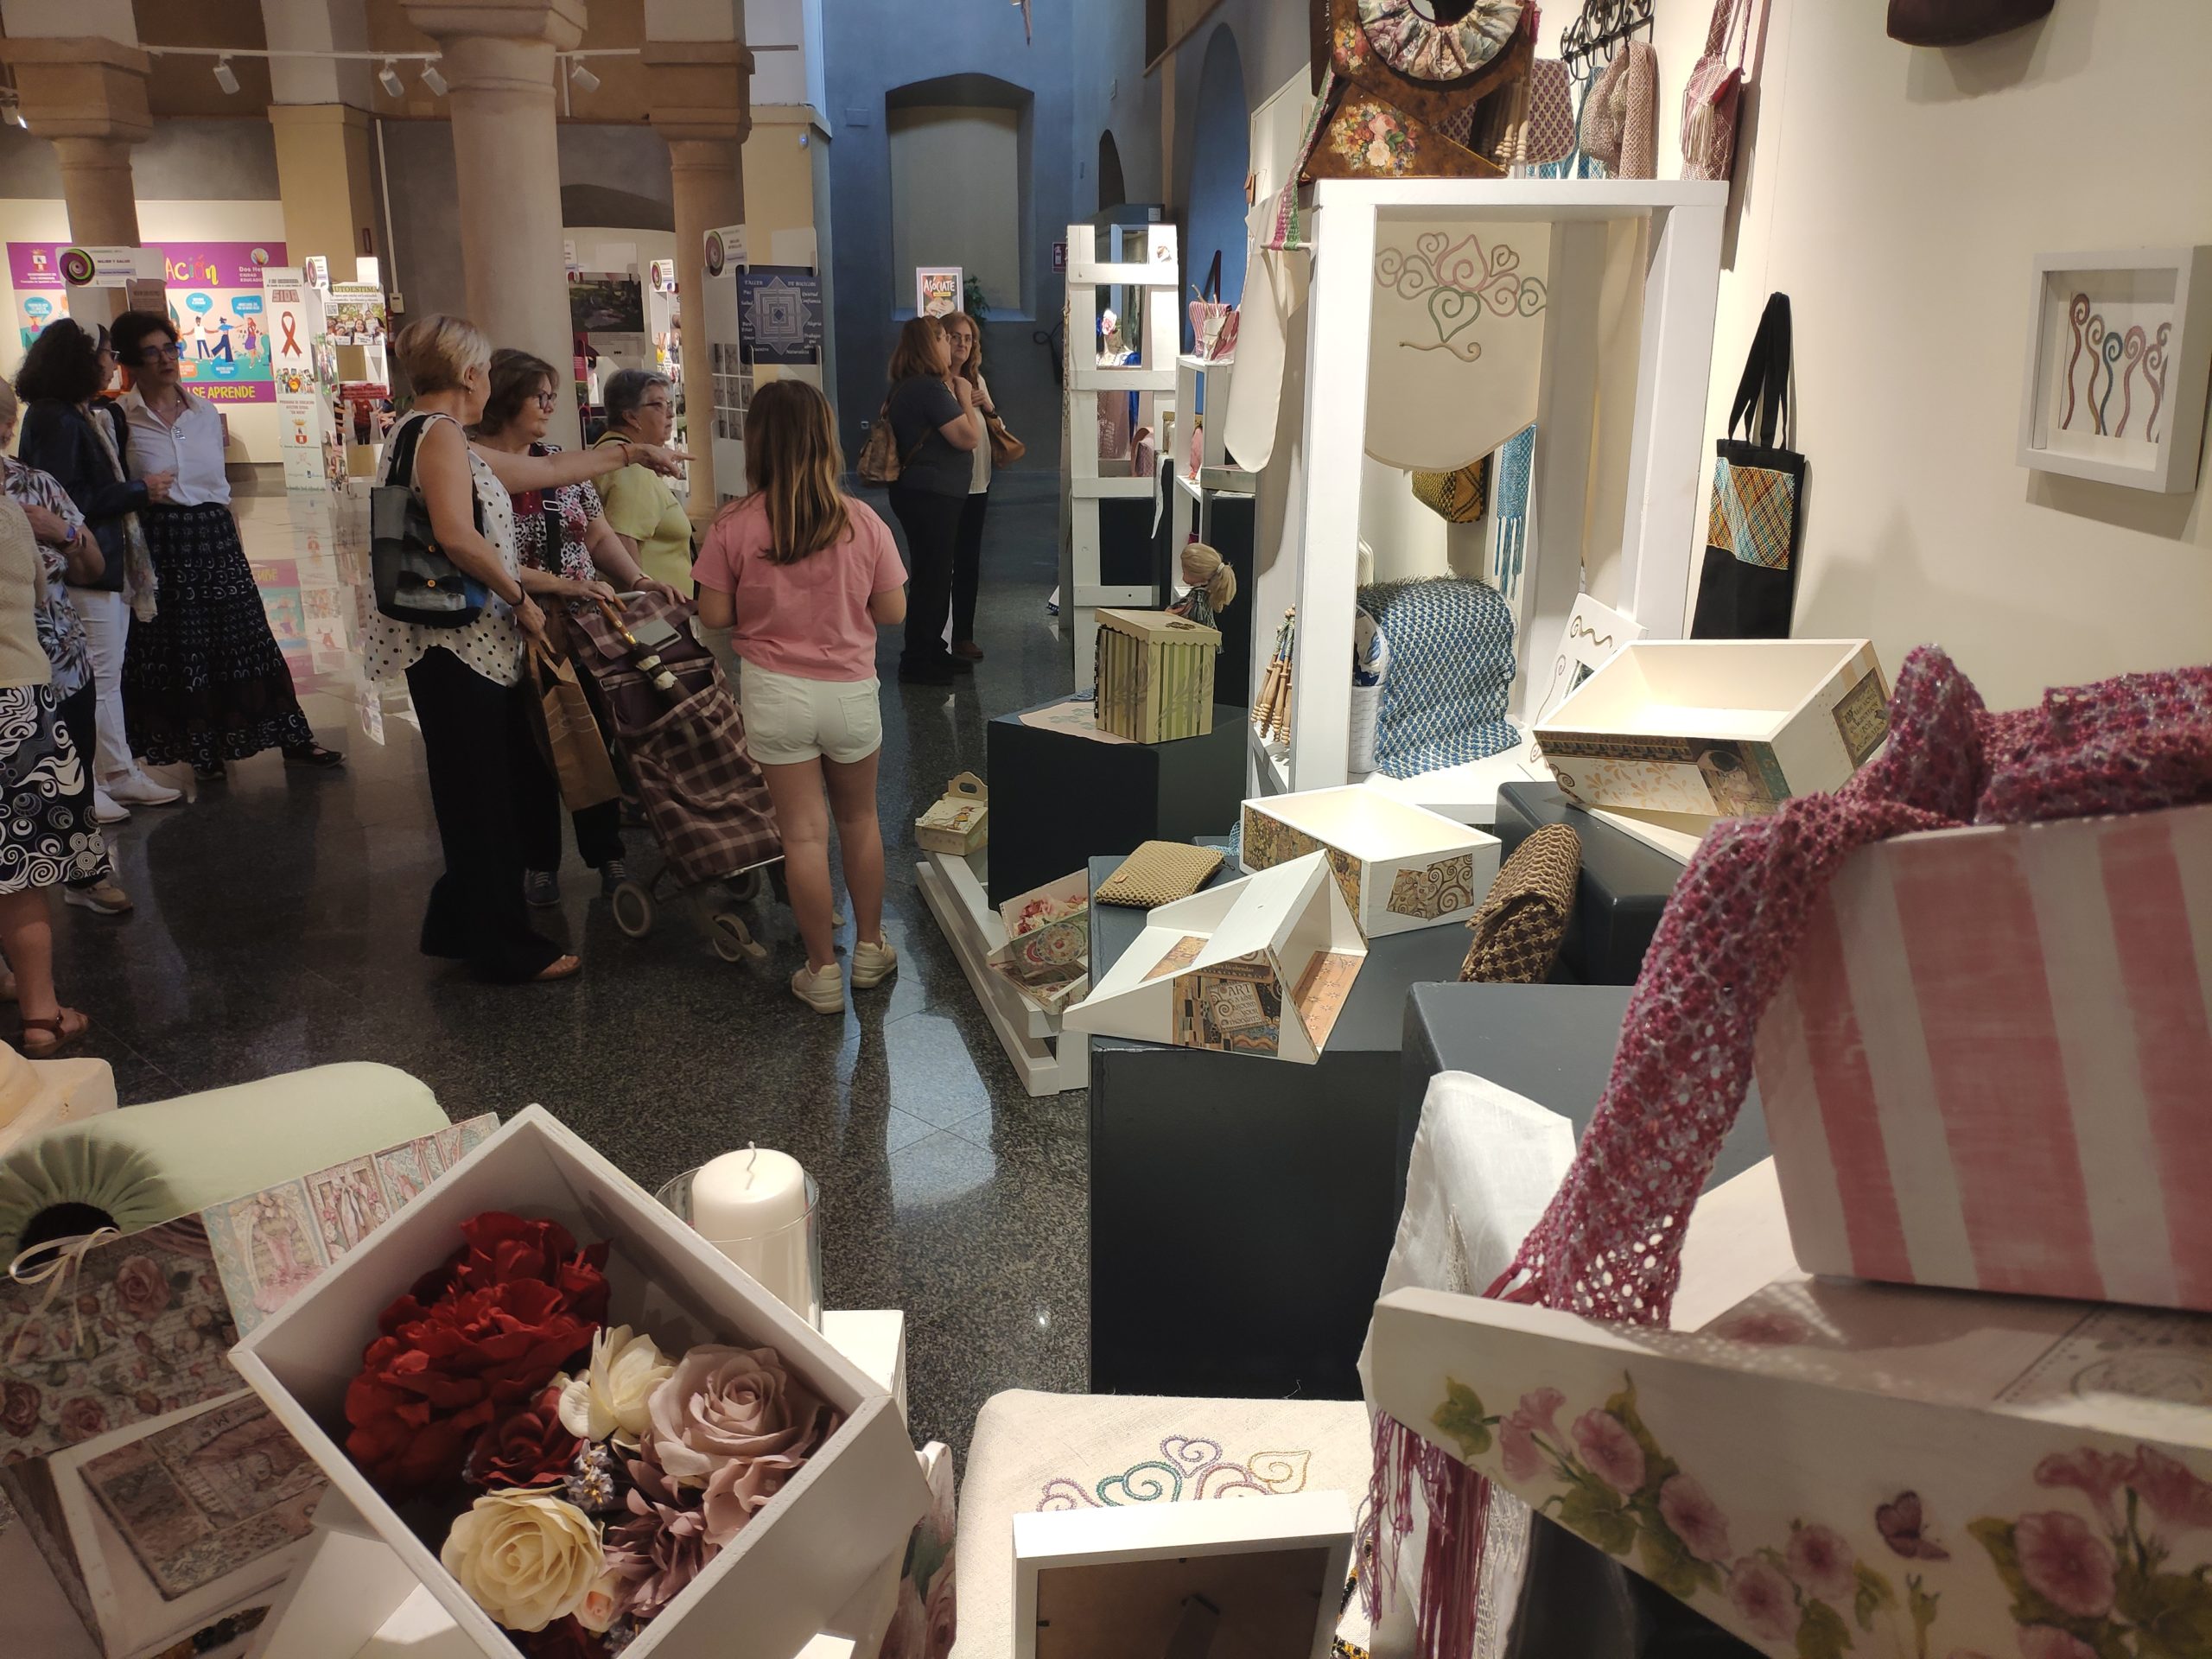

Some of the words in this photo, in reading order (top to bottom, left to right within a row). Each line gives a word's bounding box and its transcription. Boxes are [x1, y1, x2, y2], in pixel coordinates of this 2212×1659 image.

[192, 386, 206, 397] SE
[207, 385, 256, 398] APRENDE
[1228, 983, 1249, 995] ART
[1240, 1007, 1259, 1016] YOUR
